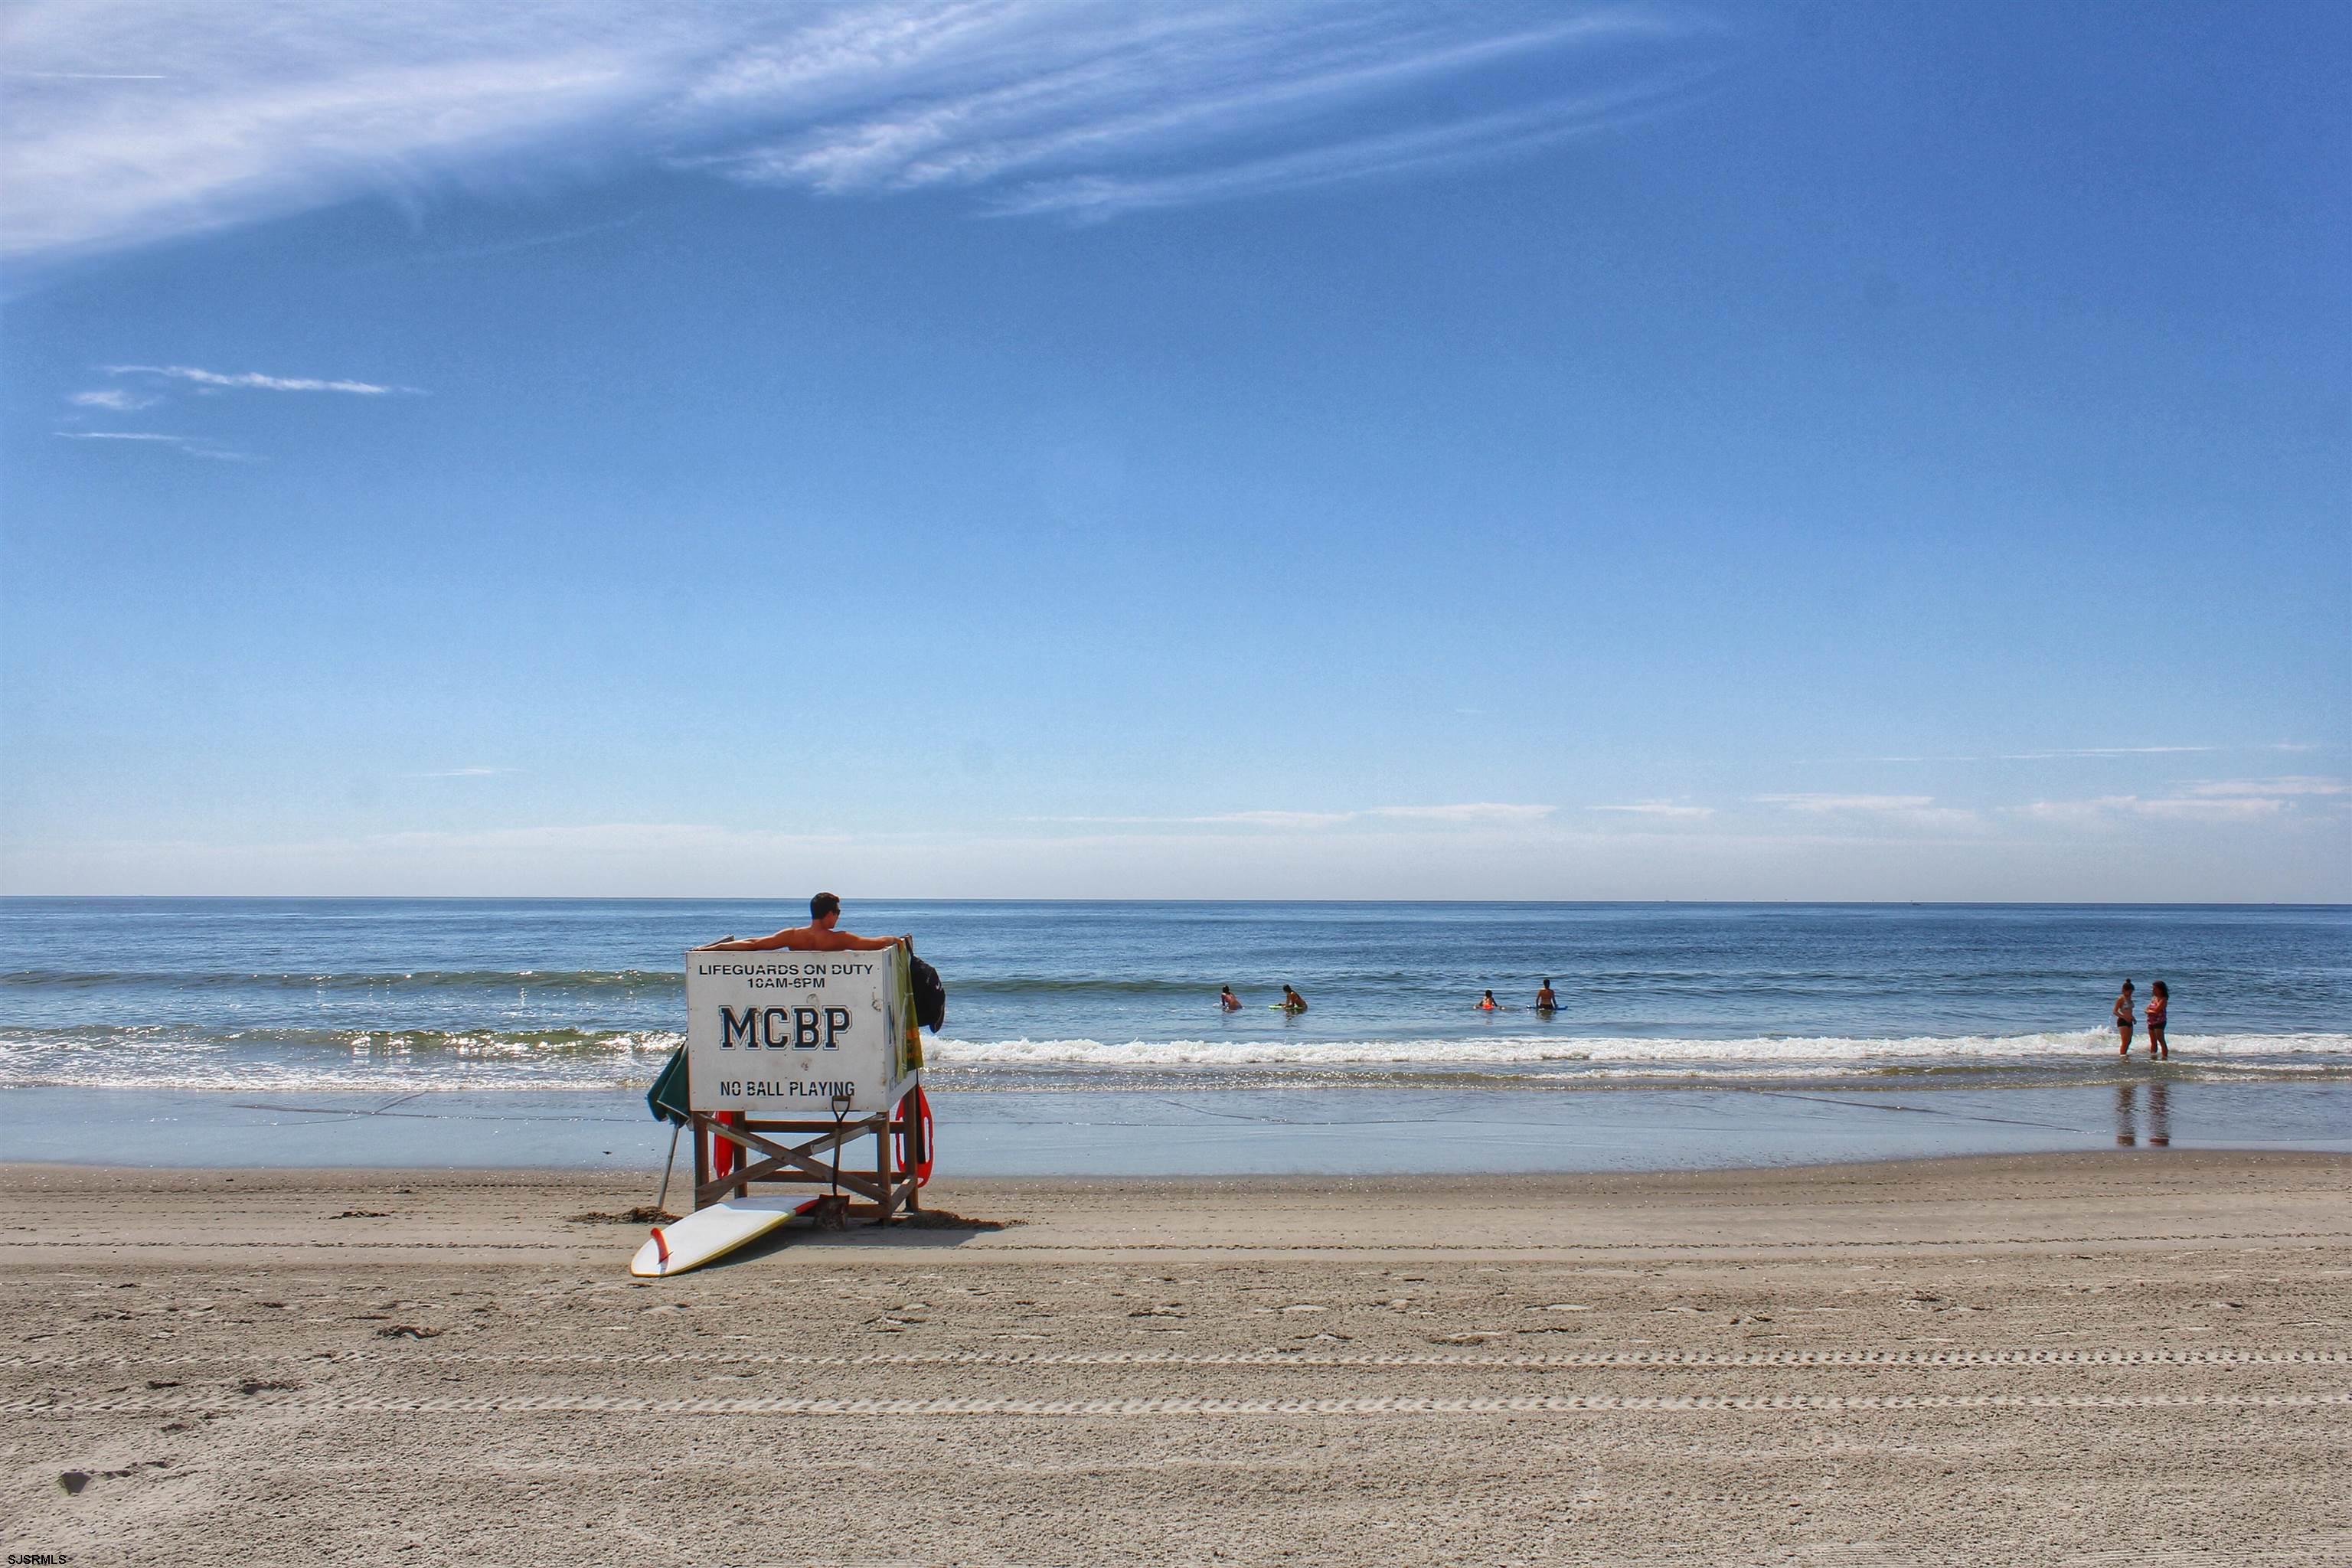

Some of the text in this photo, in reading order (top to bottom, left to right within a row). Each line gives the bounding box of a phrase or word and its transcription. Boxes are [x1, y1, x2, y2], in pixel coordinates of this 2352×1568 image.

[698, 964, 874, 975] LIFEGUARDS ON DUTY
[747, 978, 825, 988] 10AM-6PM
[718, 1005, 853, 1051] MCBP
[720, 1081, 855, 1096] NO BALL PLAYING
